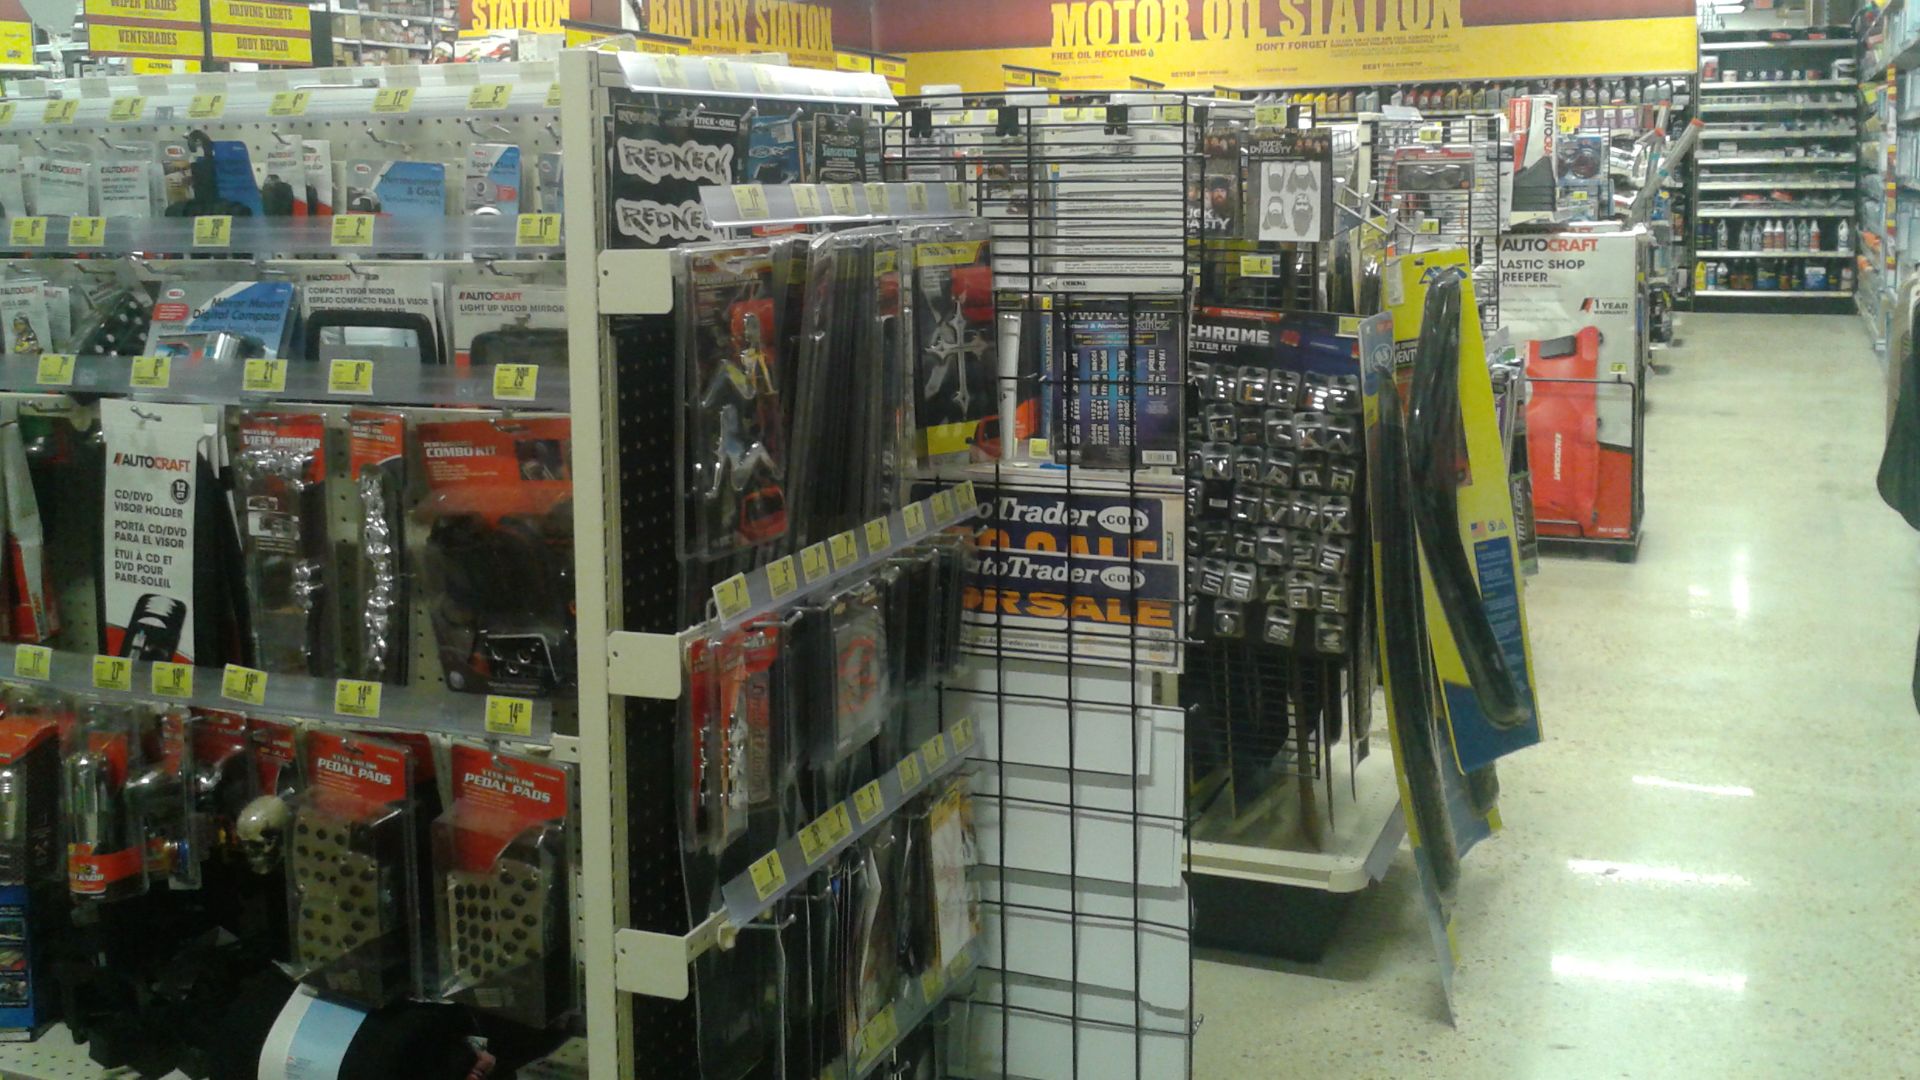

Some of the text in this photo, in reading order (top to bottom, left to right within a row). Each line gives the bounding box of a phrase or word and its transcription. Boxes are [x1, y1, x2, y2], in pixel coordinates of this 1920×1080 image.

[229, 4, 293, 21] DRIVING LIGHTS
[755, 1, 833, 51] STATION
[1051, 0, 1463, 47] MOTOR OIL STATION
[118, 29, 178, 46] VENTSHADES
[236, 36, 289, 51] BODY REPAIR
[1256, 41, 1284, 51] DON'T
[1288, 40, 1328, 50] FORGET
[1051, 49, 1147, 61] FREE OIL RECYCLING
[1544, 108, 1553, 154] AUTOCRA
[622, 142, 730, 183] REDNECK
[622, 203, 725, 238] REDNE
[1187, 209, 1213, 218] UCK
[1501, 238, 1599, 252] AUTOCRAFT
[1500, 258, 1585, 270] LASTIC SHOP
[1502, 272, 1548, 283] REEPER
[308, 287, 343, 295] COMPACT
[346, 287, 367, 295] VISOR
[466, 291, 523, 301] AUTOCRAFT
[460, 304, 565, 313] LIGHT UP VISOR MIRROR
[1602, 302, 1629, 310] YEAR
[193, 309, 228, 322] Digital
[231, 310, 280, 322] Compass
[1189, 324, 1270, 345] CHROME
[1188, 341, 1237, 352] ETTER KIT
[243, 434, 269, 445] VIEW
[426, 445, 497, 458] COMBO KIT
[121, 453, 191, 473] AUTOCRAFT
[176, 481, 187, 492] 12
[114, 489, 153, 502] CD/DVD
[114, 501, 183, 518] VISOR HOLDER
[975, 496, 1098, 528] oTrader
[115, 520, 187, 537] PORTA CD/DVD
[115, 531, 184, 549] PARA EL VISOR
[146, 553, 160, 564] CD
[163, 555, 173, 566] ET
[115, 560, 164, 576] DVD POUR
[972, 555, 1099, 585] utoTrader
[115, 572, 171, 589] PARE-SOLEIL
[1025, 591, 1174, 628] SALE
[317, 757, 356, 777] PEDAL
[358, 767, 392, 785] PADS
[464, 772, 509, 793] PEDAL
[512, 784, 551, 804] PADS
